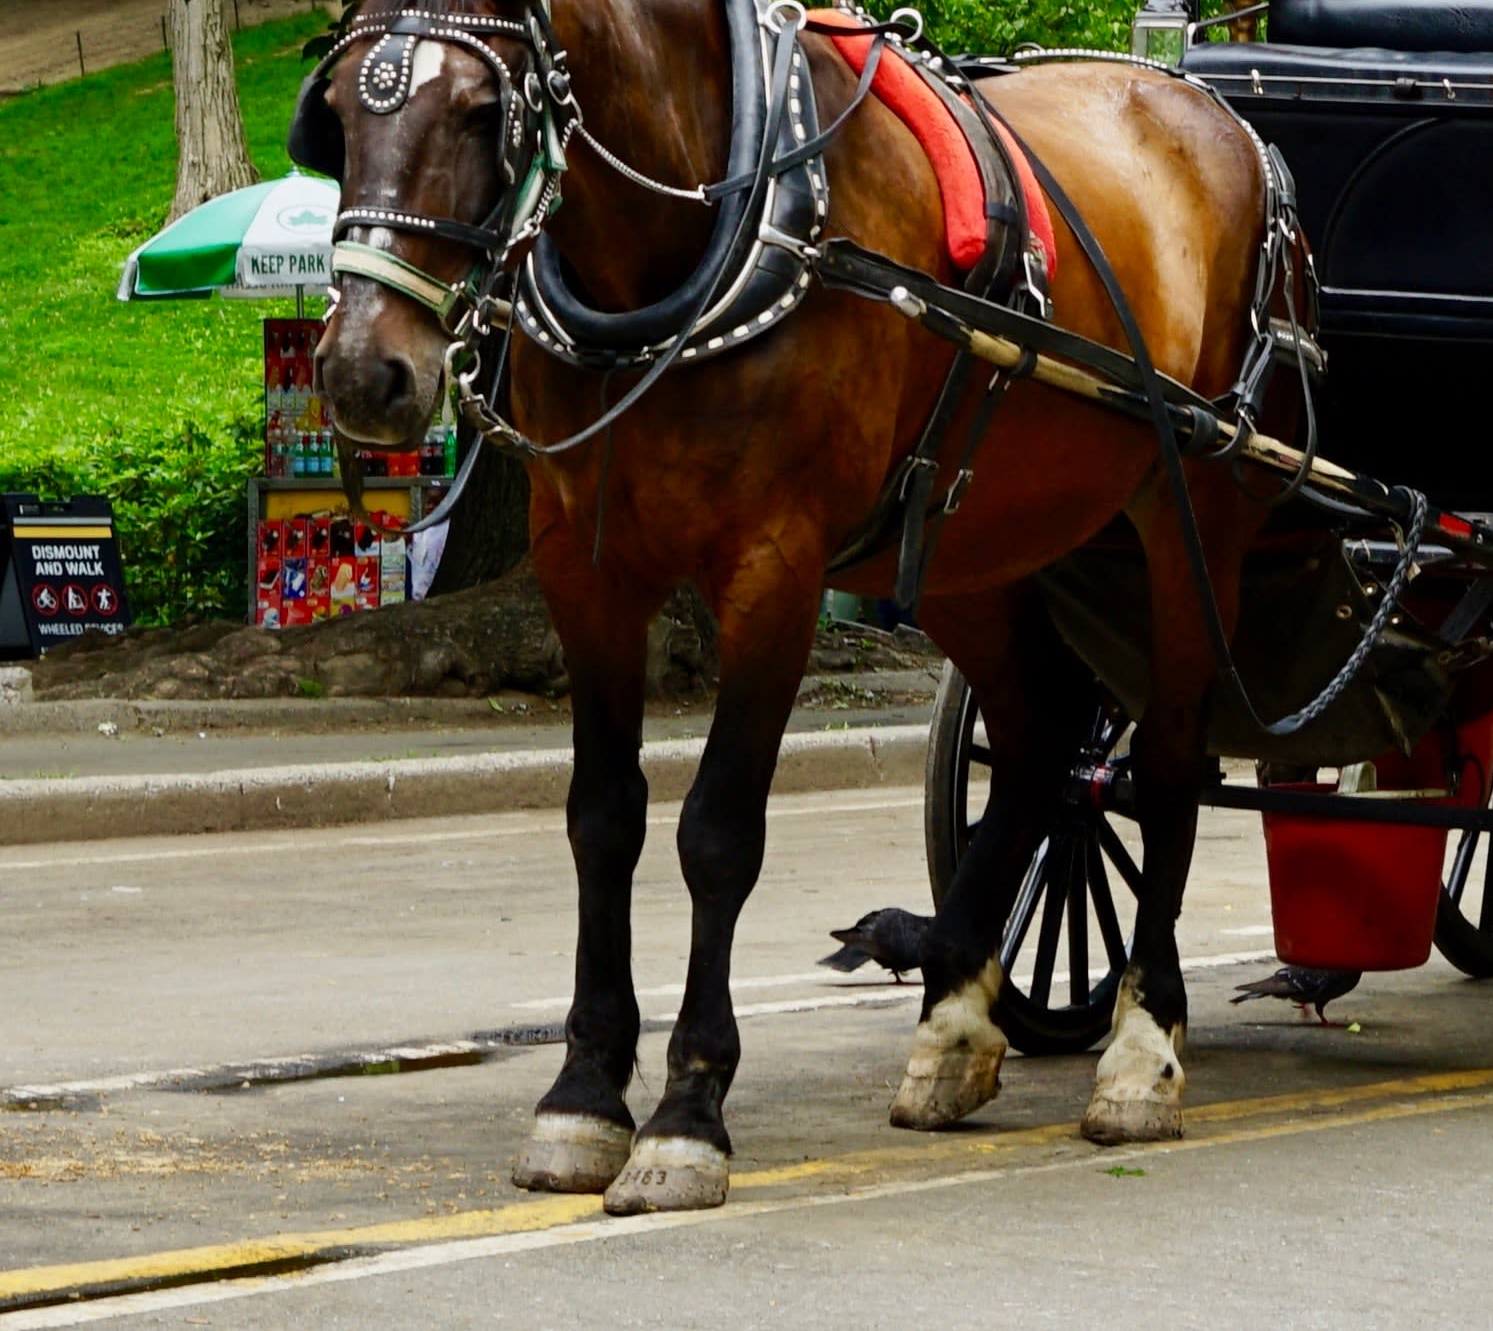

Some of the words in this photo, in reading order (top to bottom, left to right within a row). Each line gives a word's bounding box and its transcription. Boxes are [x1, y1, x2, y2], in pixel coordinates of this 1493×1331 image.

[251, 254, 284, 275] KEEP
[289, 253, 325, 274] PARK
[32, 545, 100, 560] DISMOUNT
[35, 561, 63, 576] AND
[65, 561, 105, 576] WALK
[38, 623, 84, 635] WHEELED
